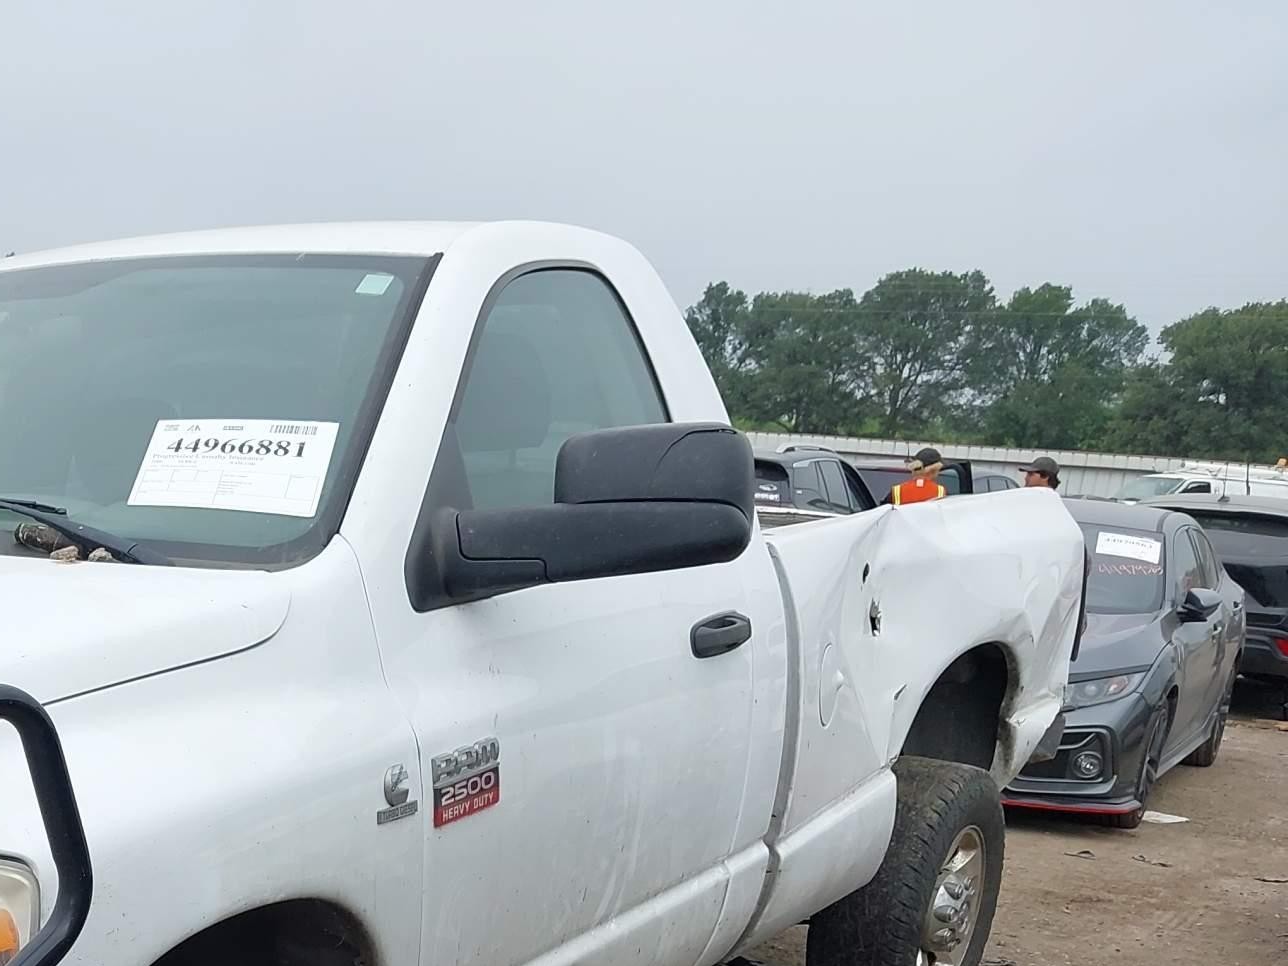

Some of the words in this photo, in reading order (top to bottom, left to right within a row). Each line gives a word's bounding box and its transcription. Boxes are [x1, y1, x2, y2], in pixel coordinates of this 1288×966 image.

[167, 437, 307, 459] 44966881
[441, 771, 495, 807] 2500
[442, 801, 471, 823] HEAVY
[473, 792, 495, 810] DUTY
